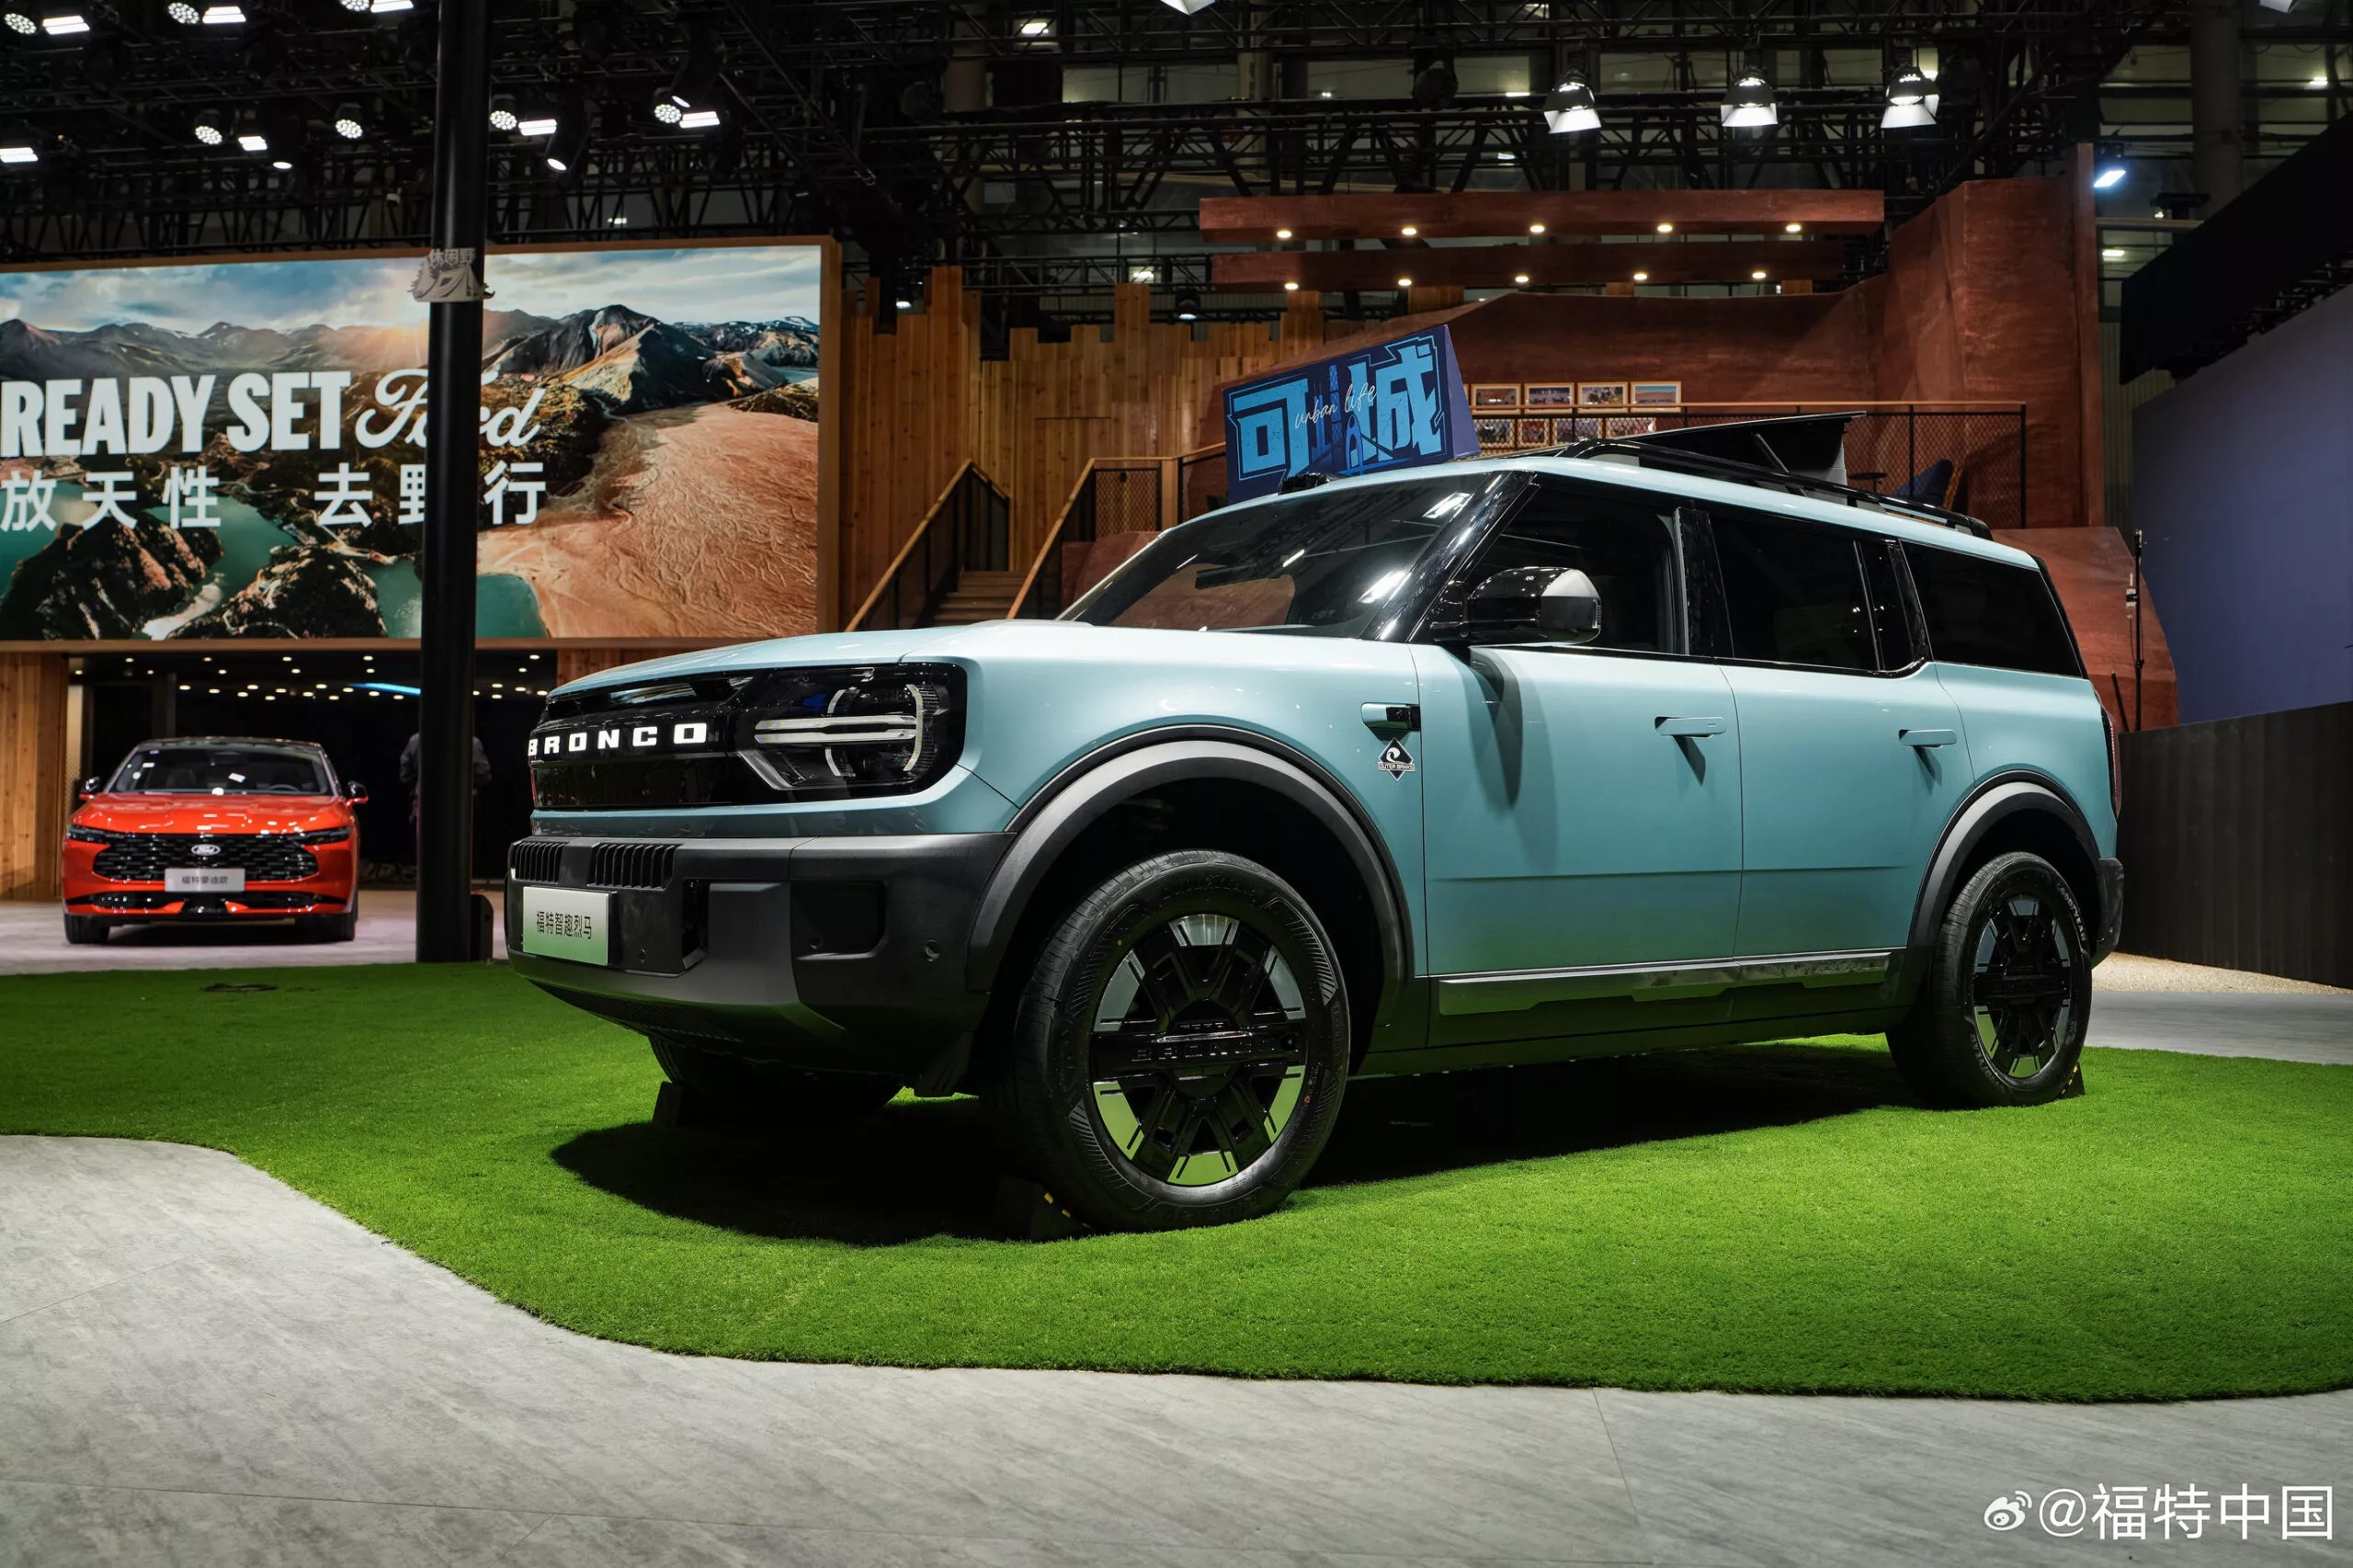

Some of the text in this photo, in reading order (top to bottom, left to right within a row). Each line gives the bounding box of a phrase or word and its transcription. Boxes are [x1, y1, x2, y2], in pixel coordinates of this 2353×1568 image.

[1, 368, 547, 458] READY SET Fd
[1295, 381, 1377, 429] urban life
[1, 465, 221, 532] 放天性
[528, 722, 708, 756] BRONCO
[536, 911, 592, 939] 福特智趣烈马
